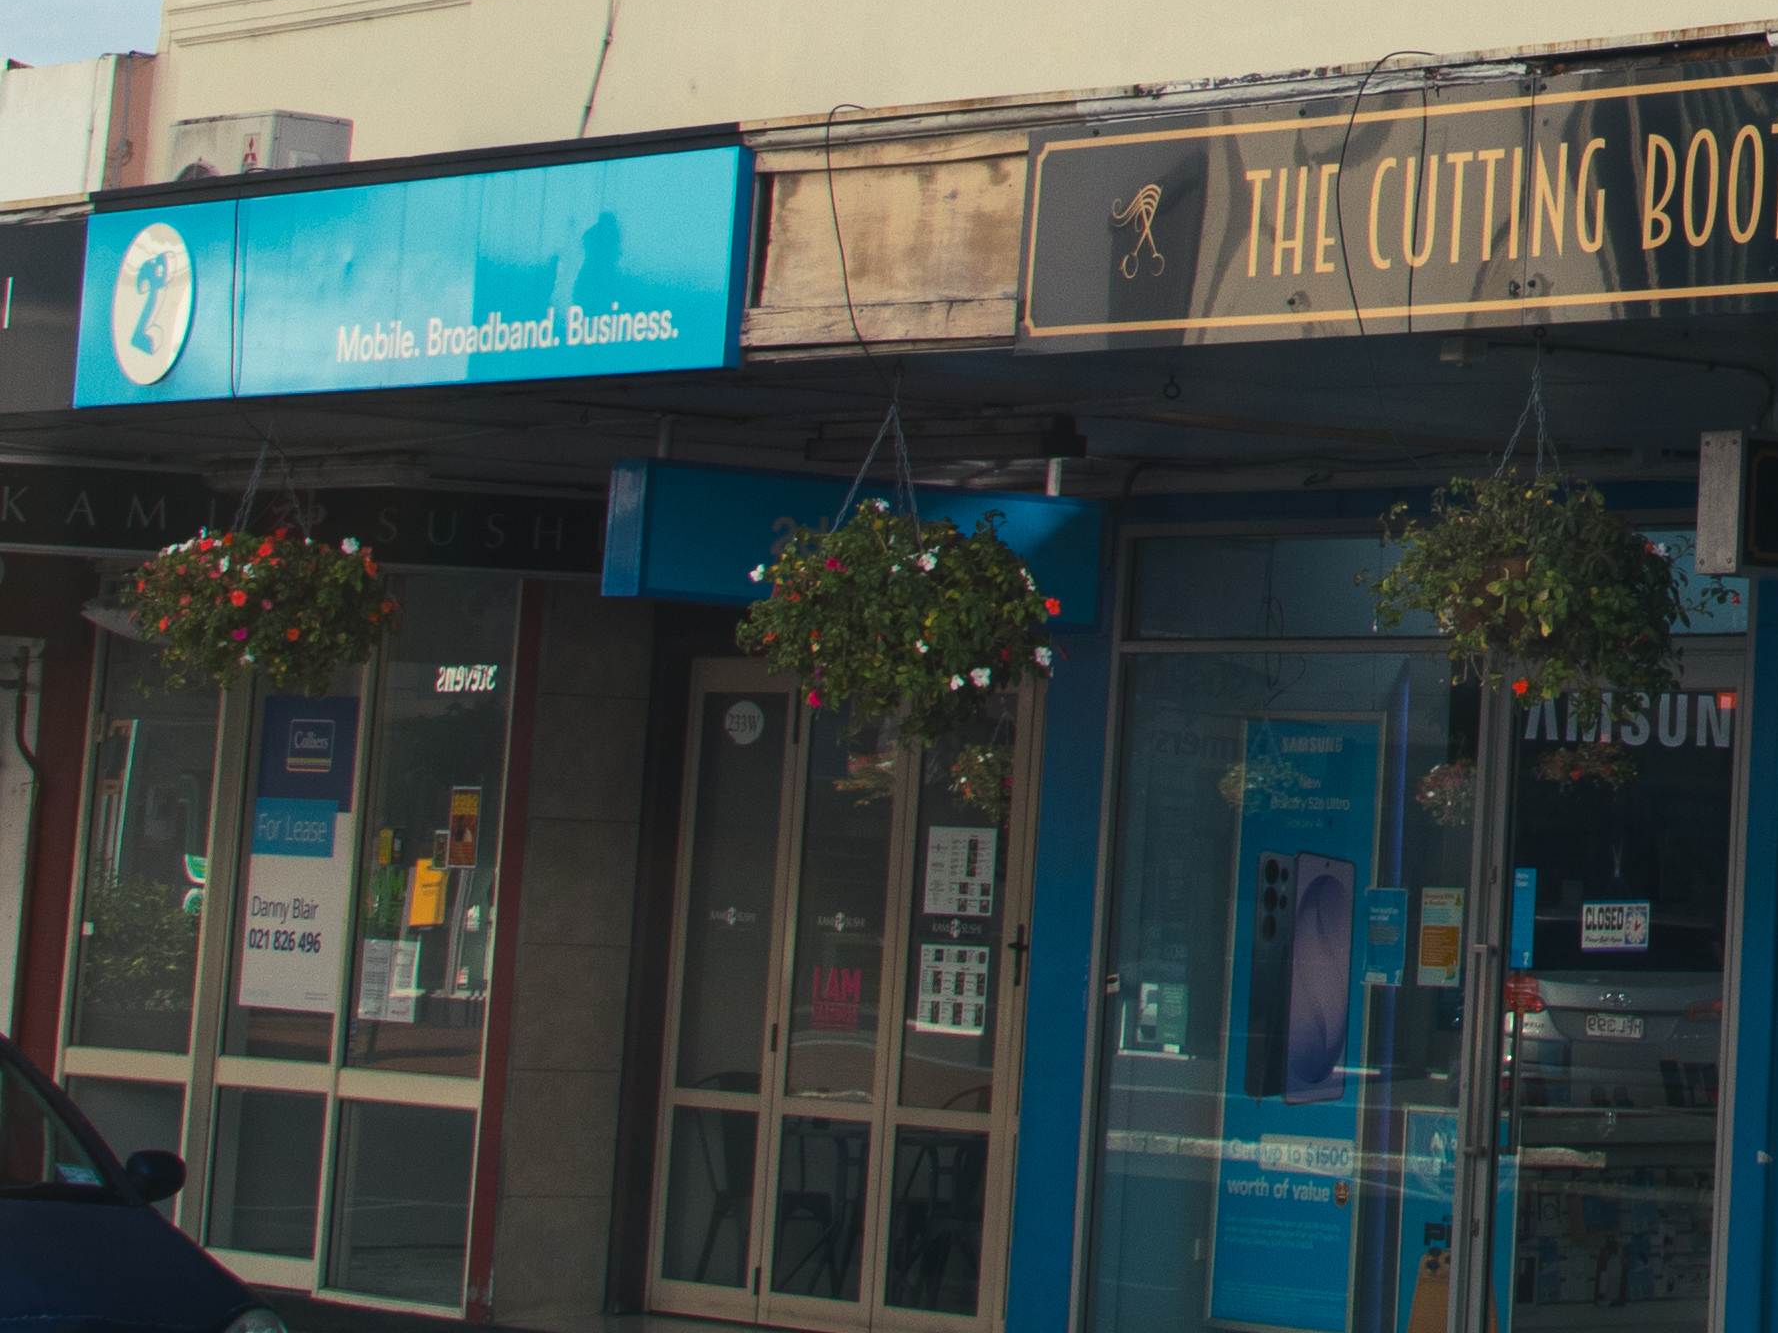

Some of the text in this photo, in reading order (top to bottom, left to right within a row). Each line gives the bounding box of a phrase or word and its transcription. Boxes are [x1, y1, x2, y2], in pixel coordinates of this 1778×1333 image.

[1245, 164, 1337, 279] THE
[1367, 137, 1606, 271] CUTTING
[336, 301, 678, 362] Mobile. Broadband. Business.
[1524, 691, 1731, 747] AMSUN
[294, 730, 329, 750] Colliers
[1282, 736, 1343, 753] SAMSUNG
[256, 812, 329, 843] For Lease
[251, 896, 319, 924] Danny Blair
[1585, 906, 1624, 931] CLOSED
[248, 928, 322, 953] 021 826 496
[1306, 1142, 1349, 1168] $1500
[1227, 1176, 1331, 1202] worth of value
